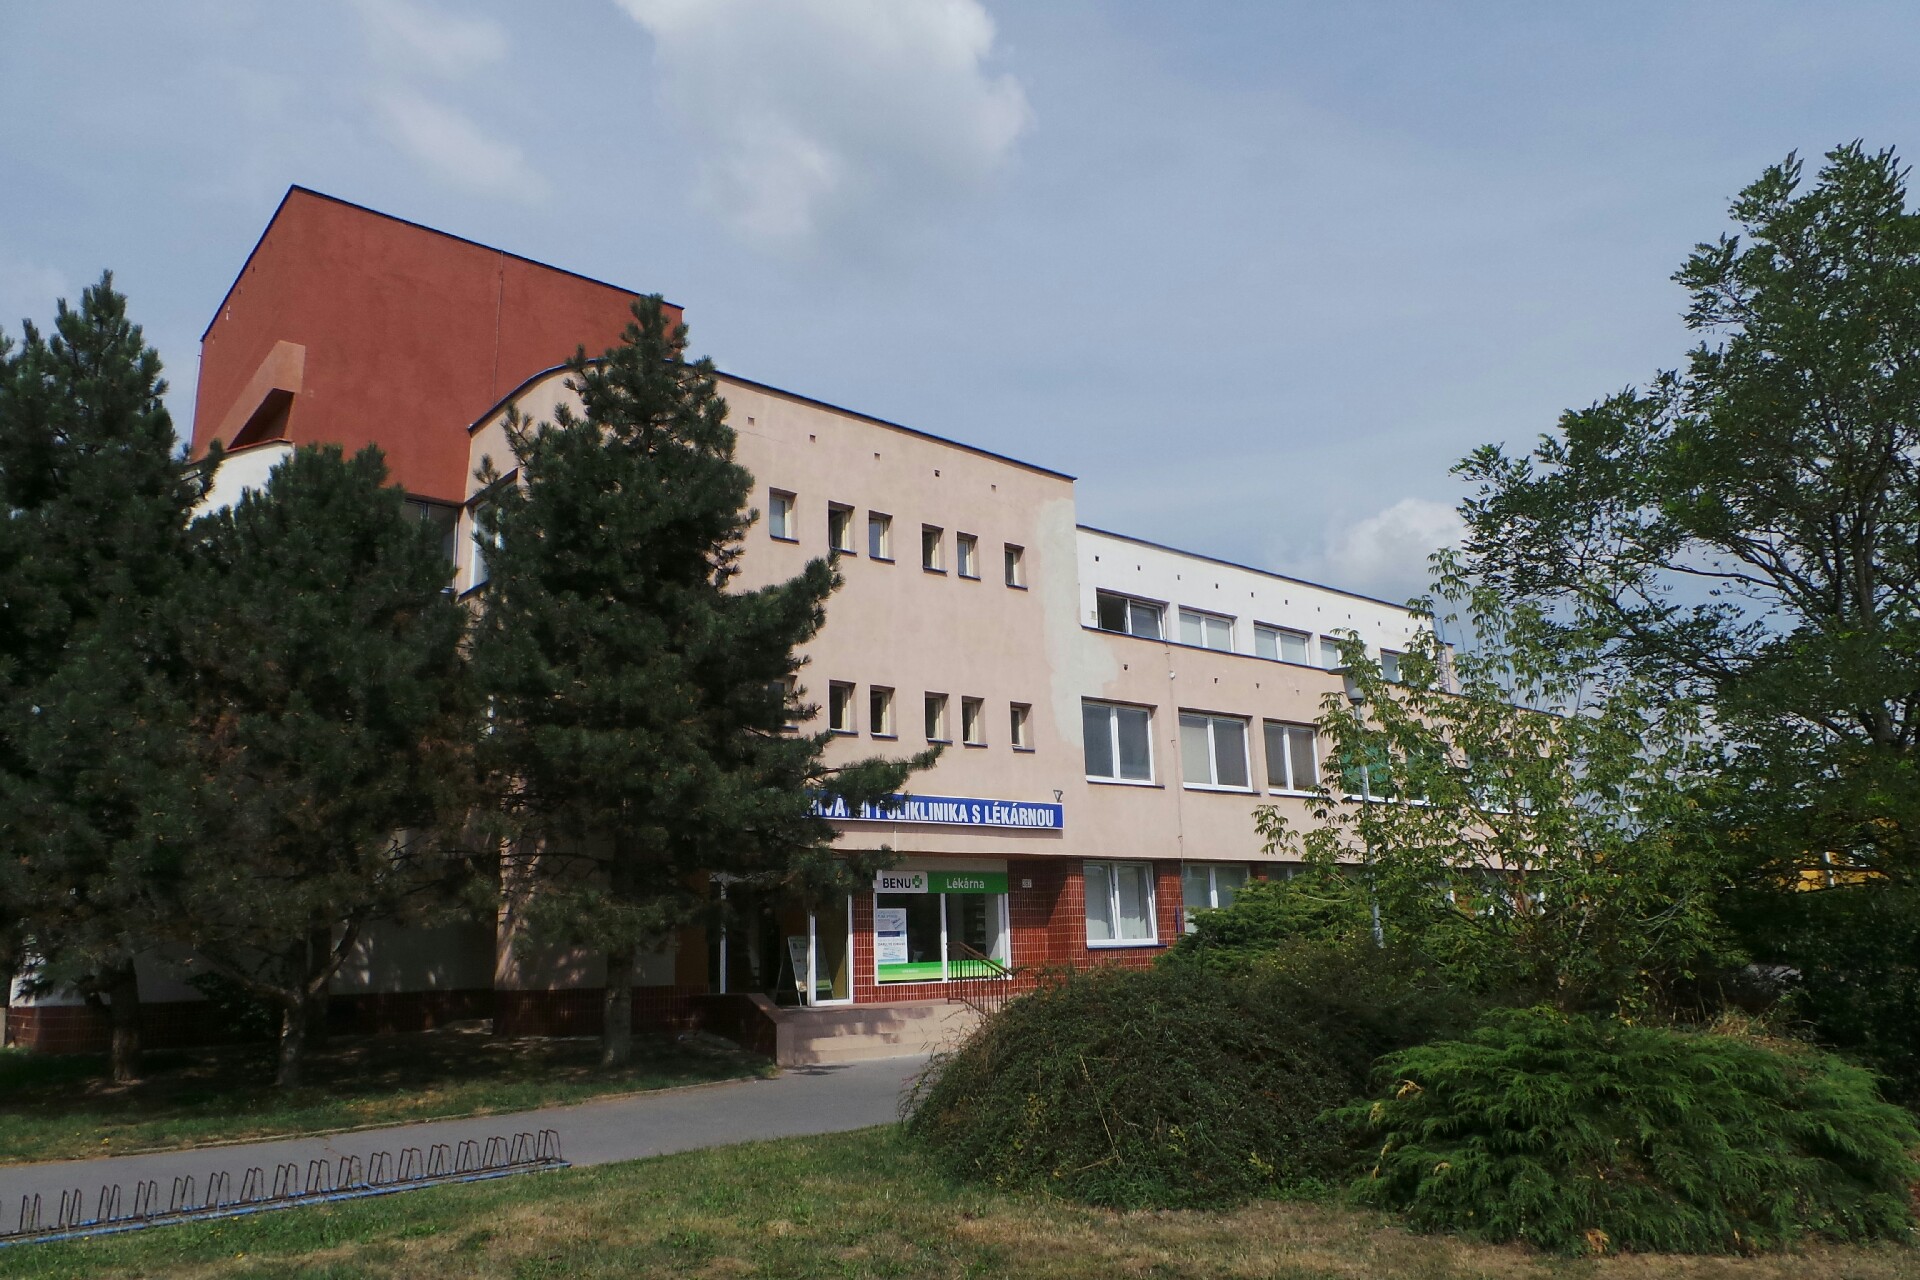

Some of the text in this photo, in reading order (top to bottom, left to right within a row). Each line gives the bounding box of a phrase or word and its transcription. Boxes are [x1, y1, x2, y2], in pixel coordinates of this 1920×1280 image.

[971, 804, 981, 824] S
[984, 801, 1055, 827] LÉKÁRNOU
[882, 877, 911, 889] BENU
[946, 877, 985, 889] Lékárna
